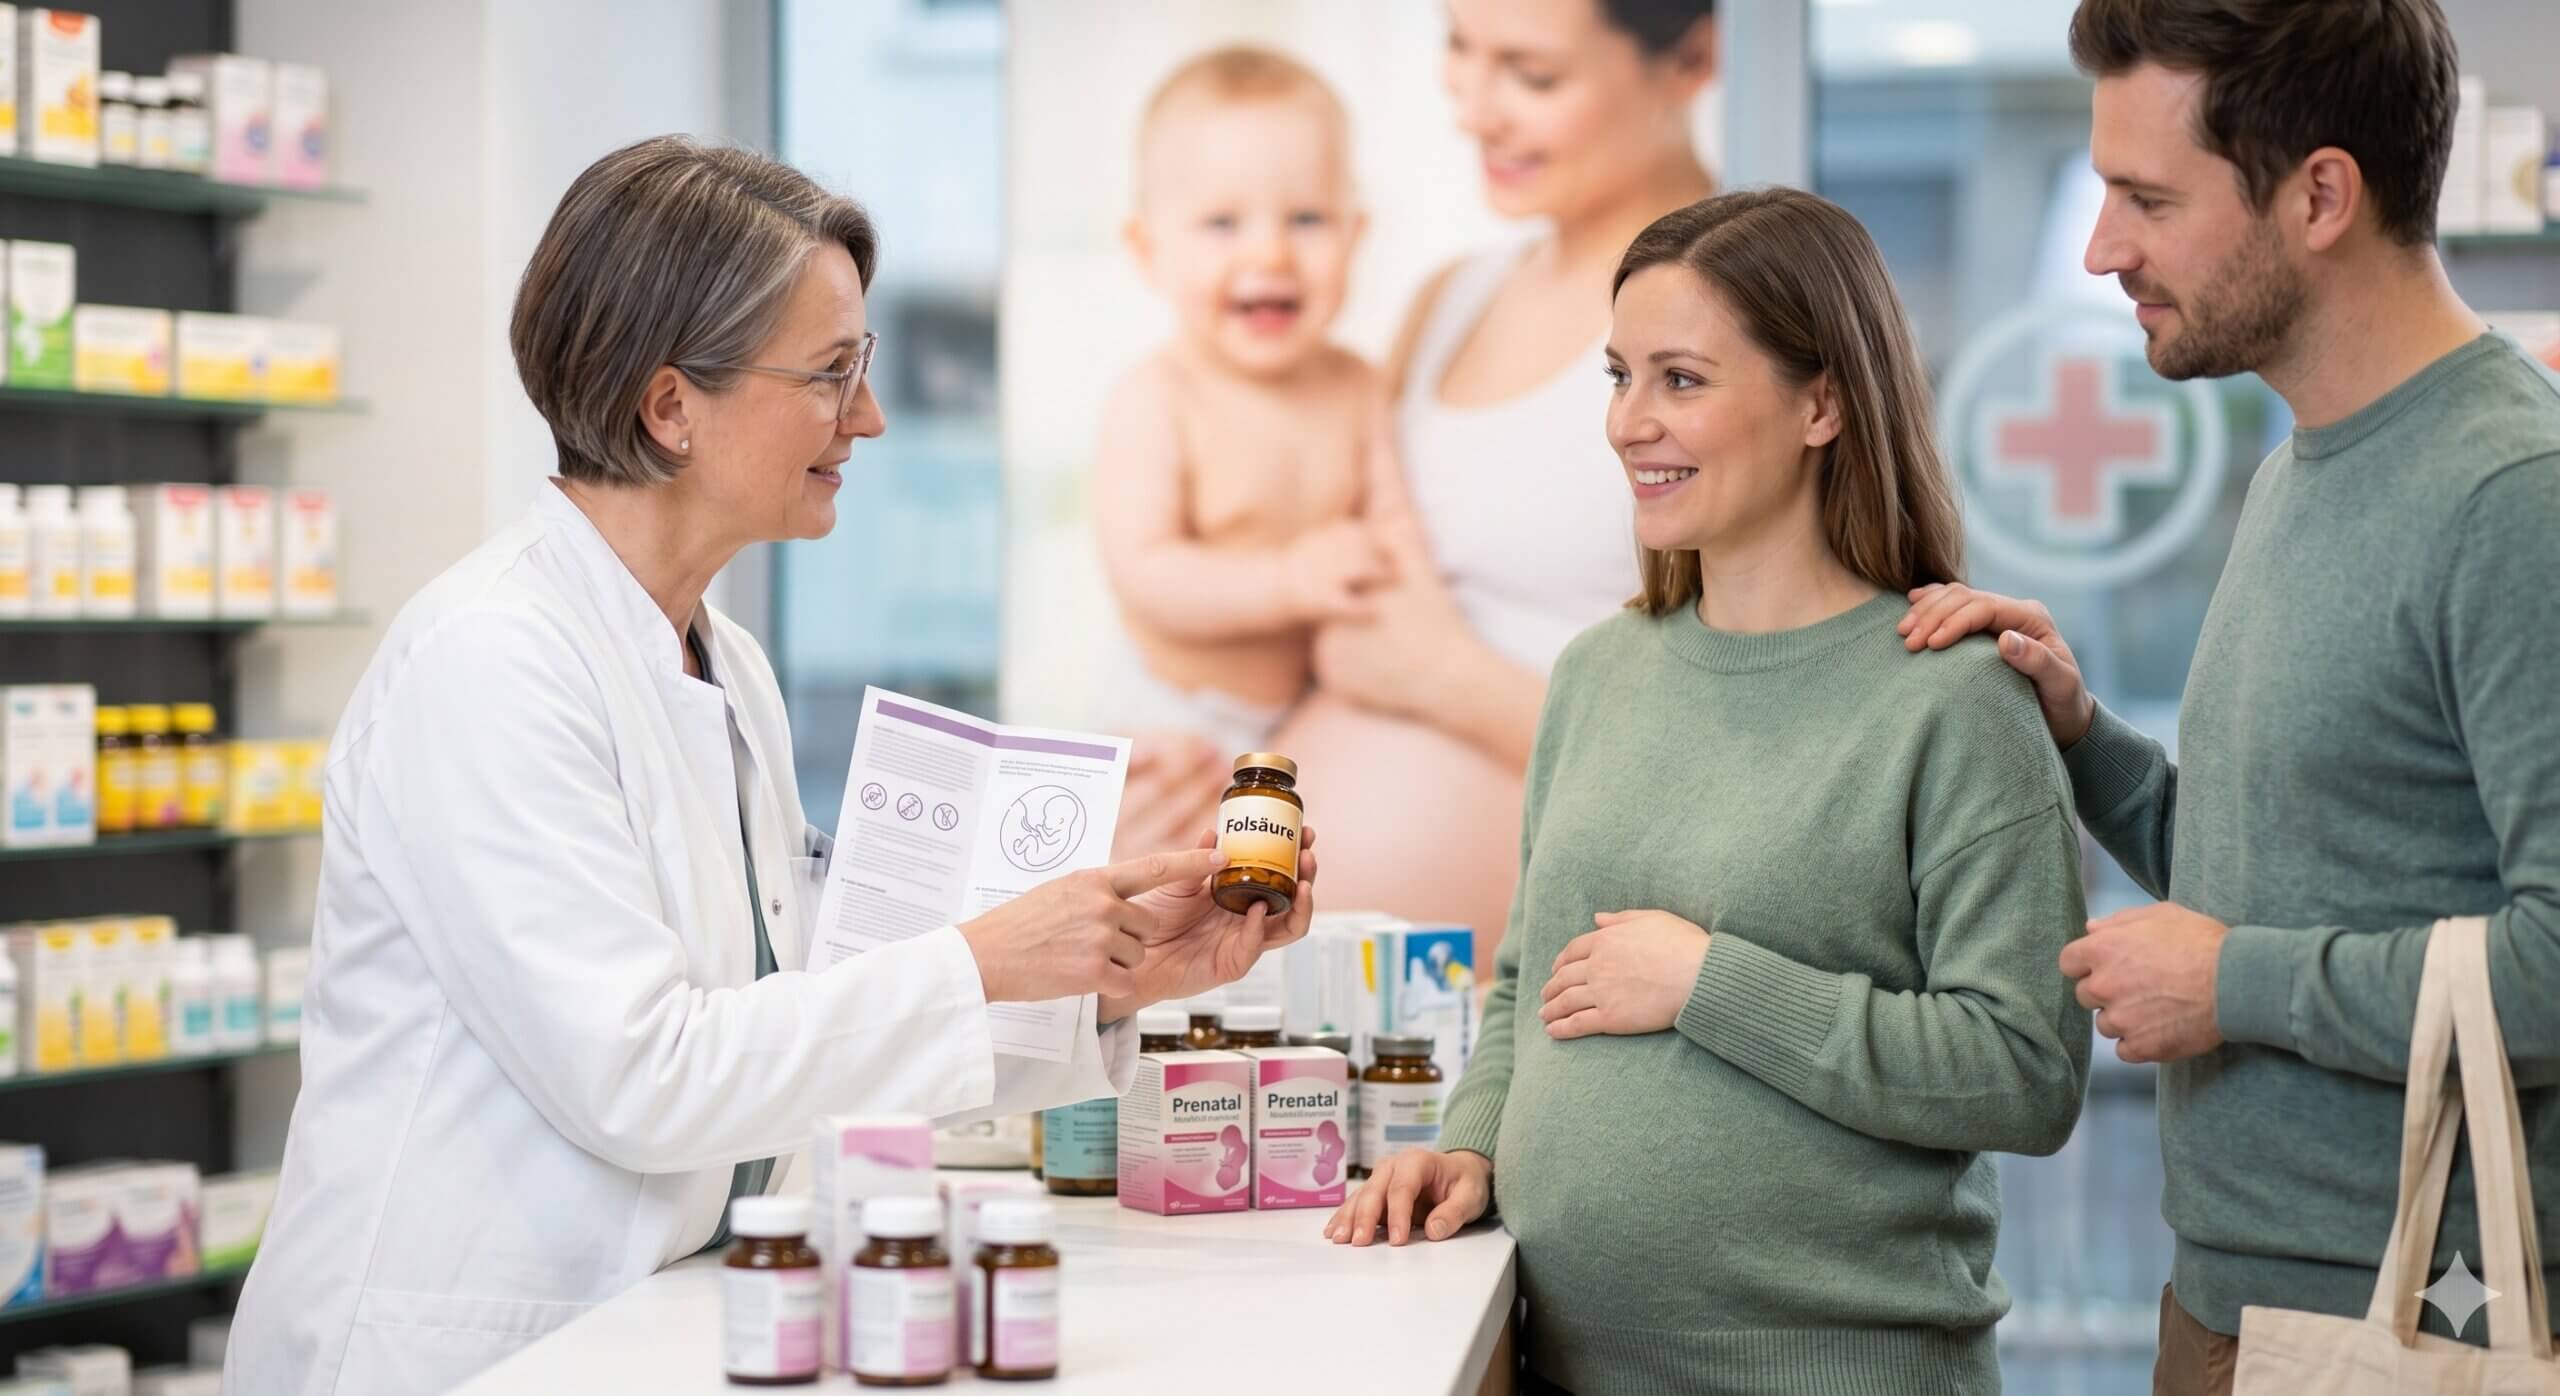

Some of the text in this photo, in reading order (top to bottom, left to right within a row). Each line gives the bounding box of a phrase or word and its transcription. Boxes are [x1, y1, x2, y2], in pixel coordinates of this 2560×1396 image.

[1226, 817, 1295, 841] Folsäure
[1173, 1094, 1241, 1113] Prenatal
[1268, 1090, 1338, 1108] Prenatal
